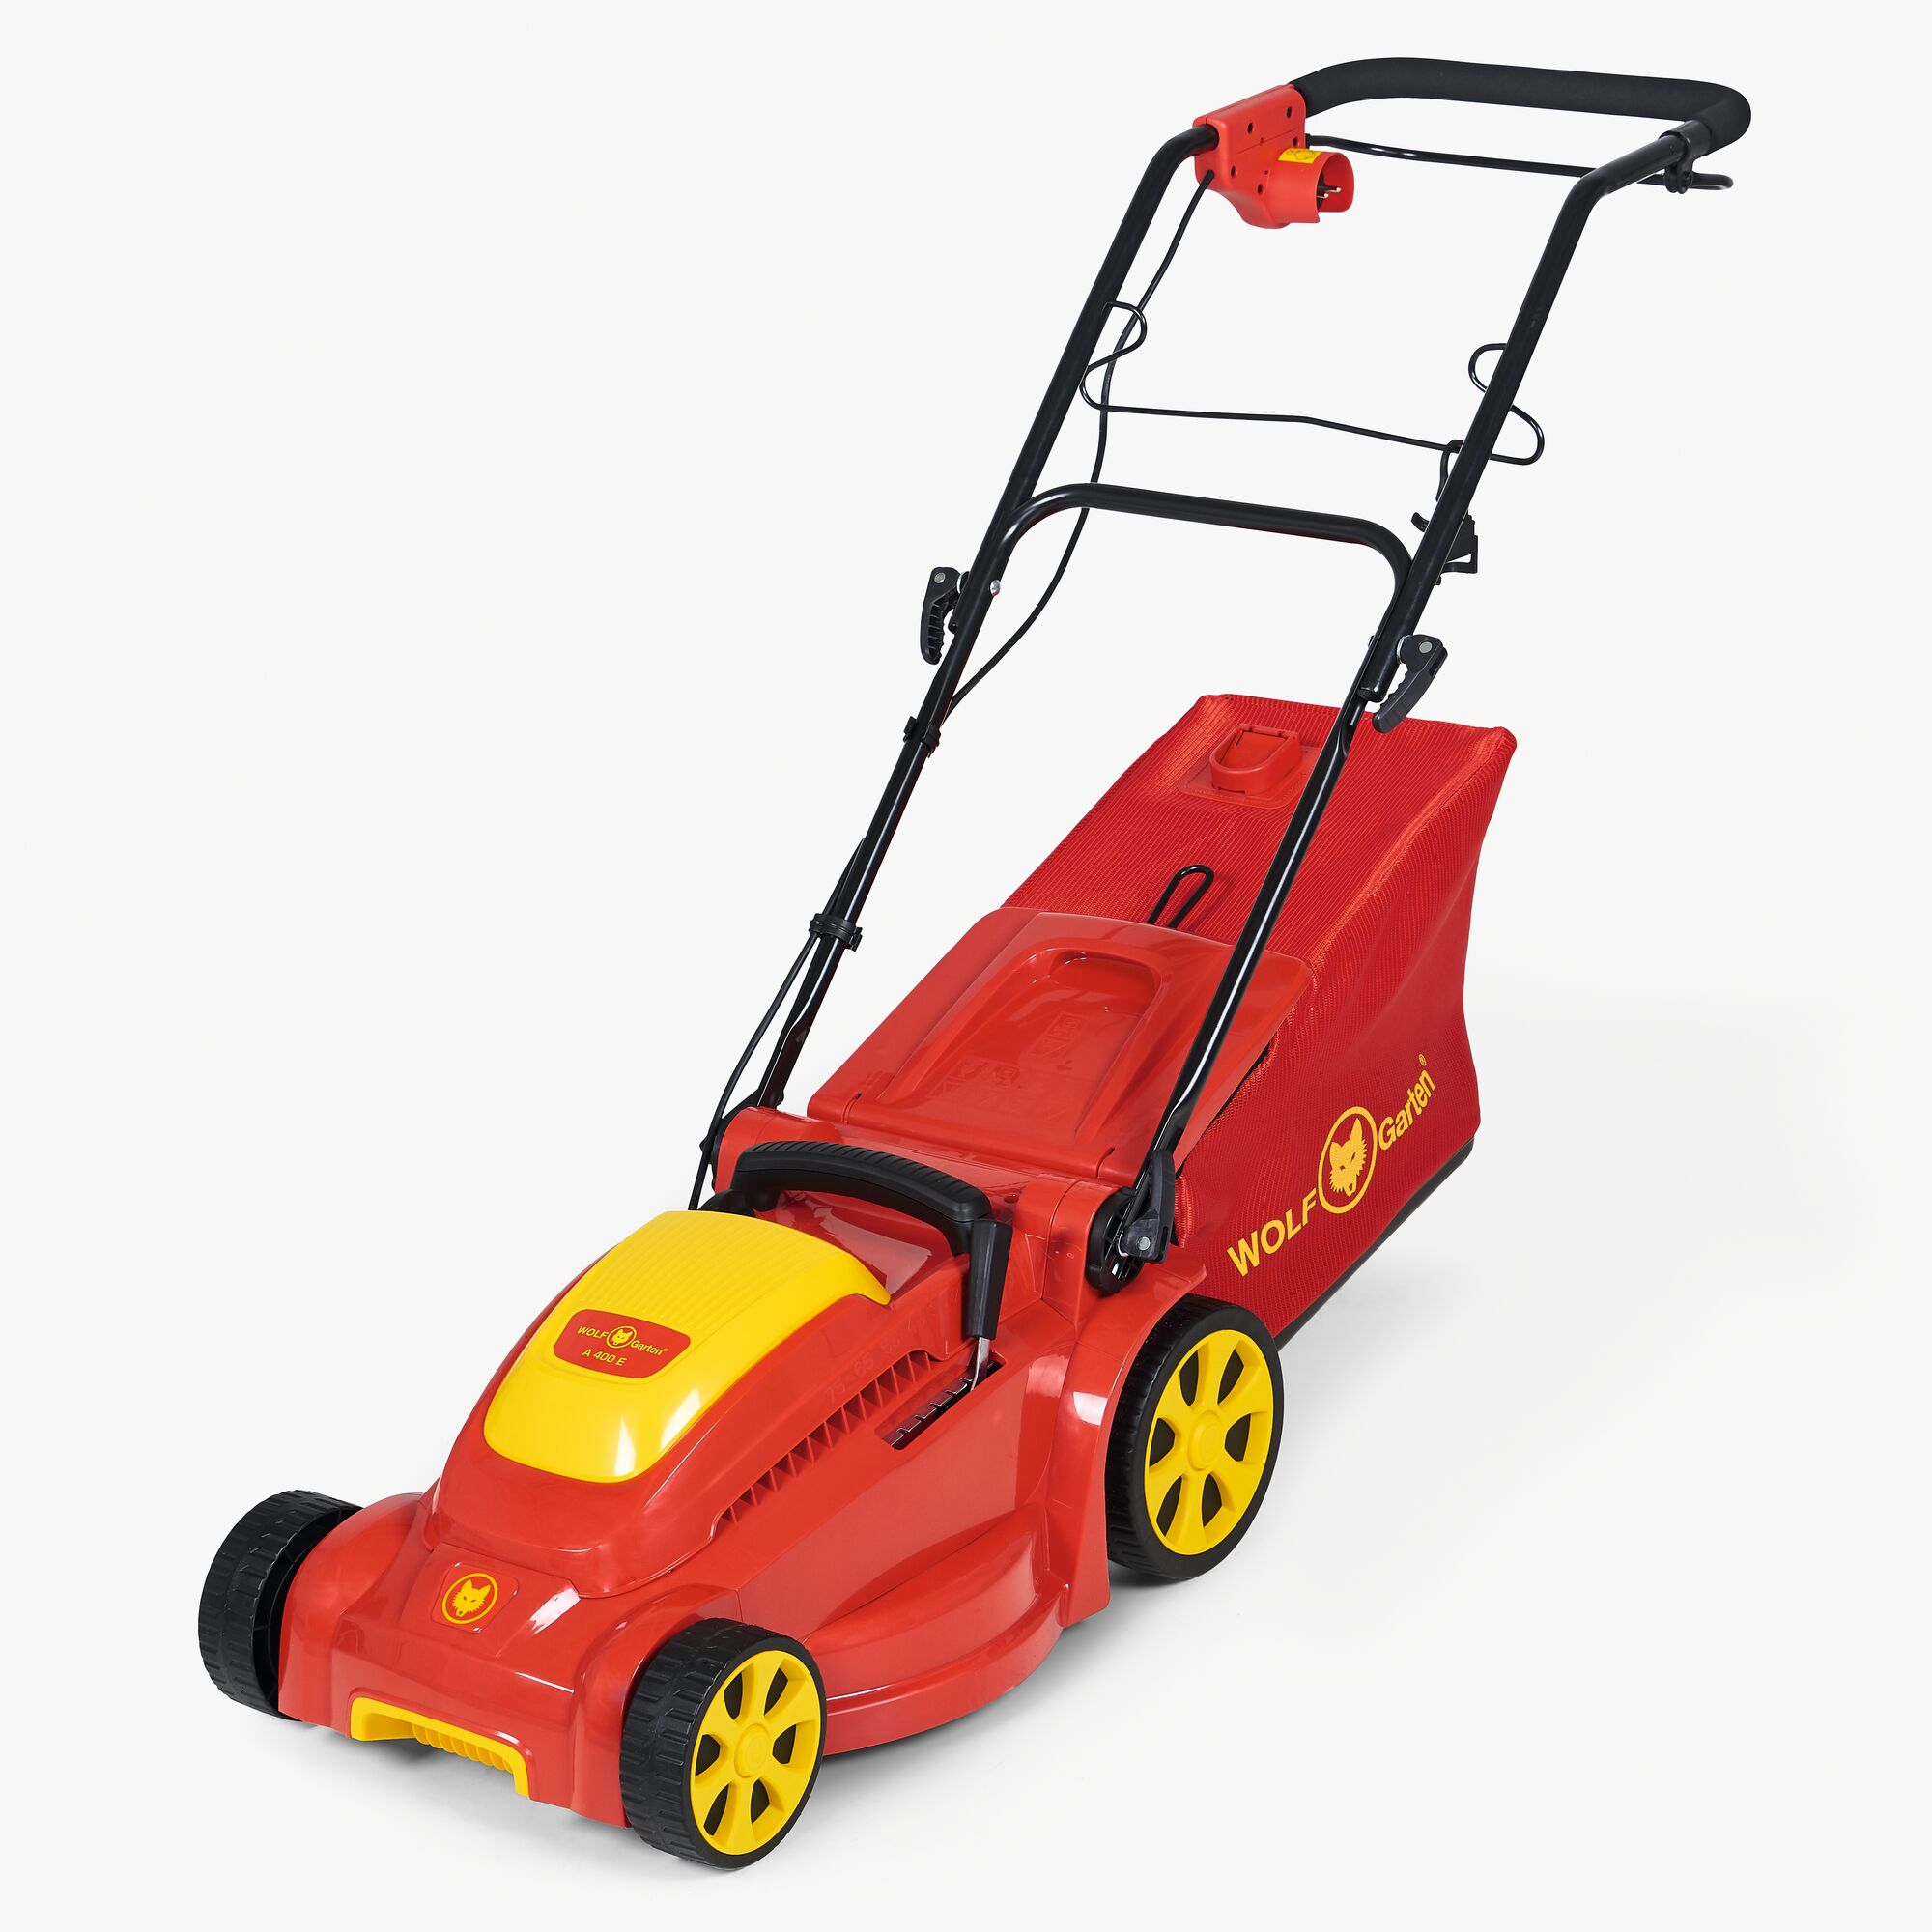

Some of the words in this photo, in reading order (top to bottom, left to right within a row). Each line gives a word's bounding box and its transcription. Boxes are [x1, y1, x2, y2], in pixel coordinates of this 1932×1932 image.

[1227, 1188, 1317, 1277] WOLF
[577, 1325, 610, 1340] WOLF
[582, 1349, 592, 1357] A
[593, 1351, 617, 1364] 400
[616, 1357, 628, 1367] E
